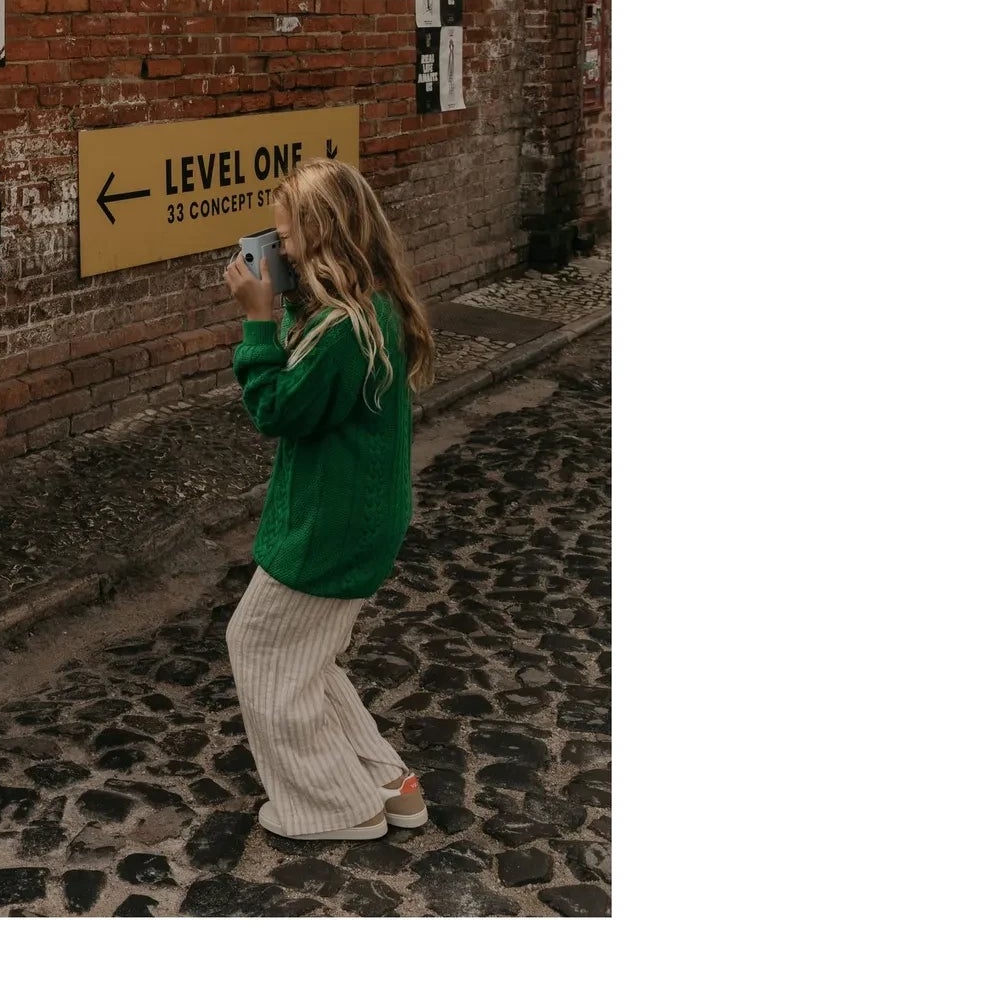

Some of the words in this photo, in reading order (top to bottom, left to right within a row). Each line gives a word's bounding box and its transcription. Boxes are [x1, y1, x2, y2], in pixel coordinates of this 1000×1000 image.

[165, 150, 245, 196] LEVEL
[167, 202, 184, 224] 33
[189, 191, 253, 220] CONCEPT
